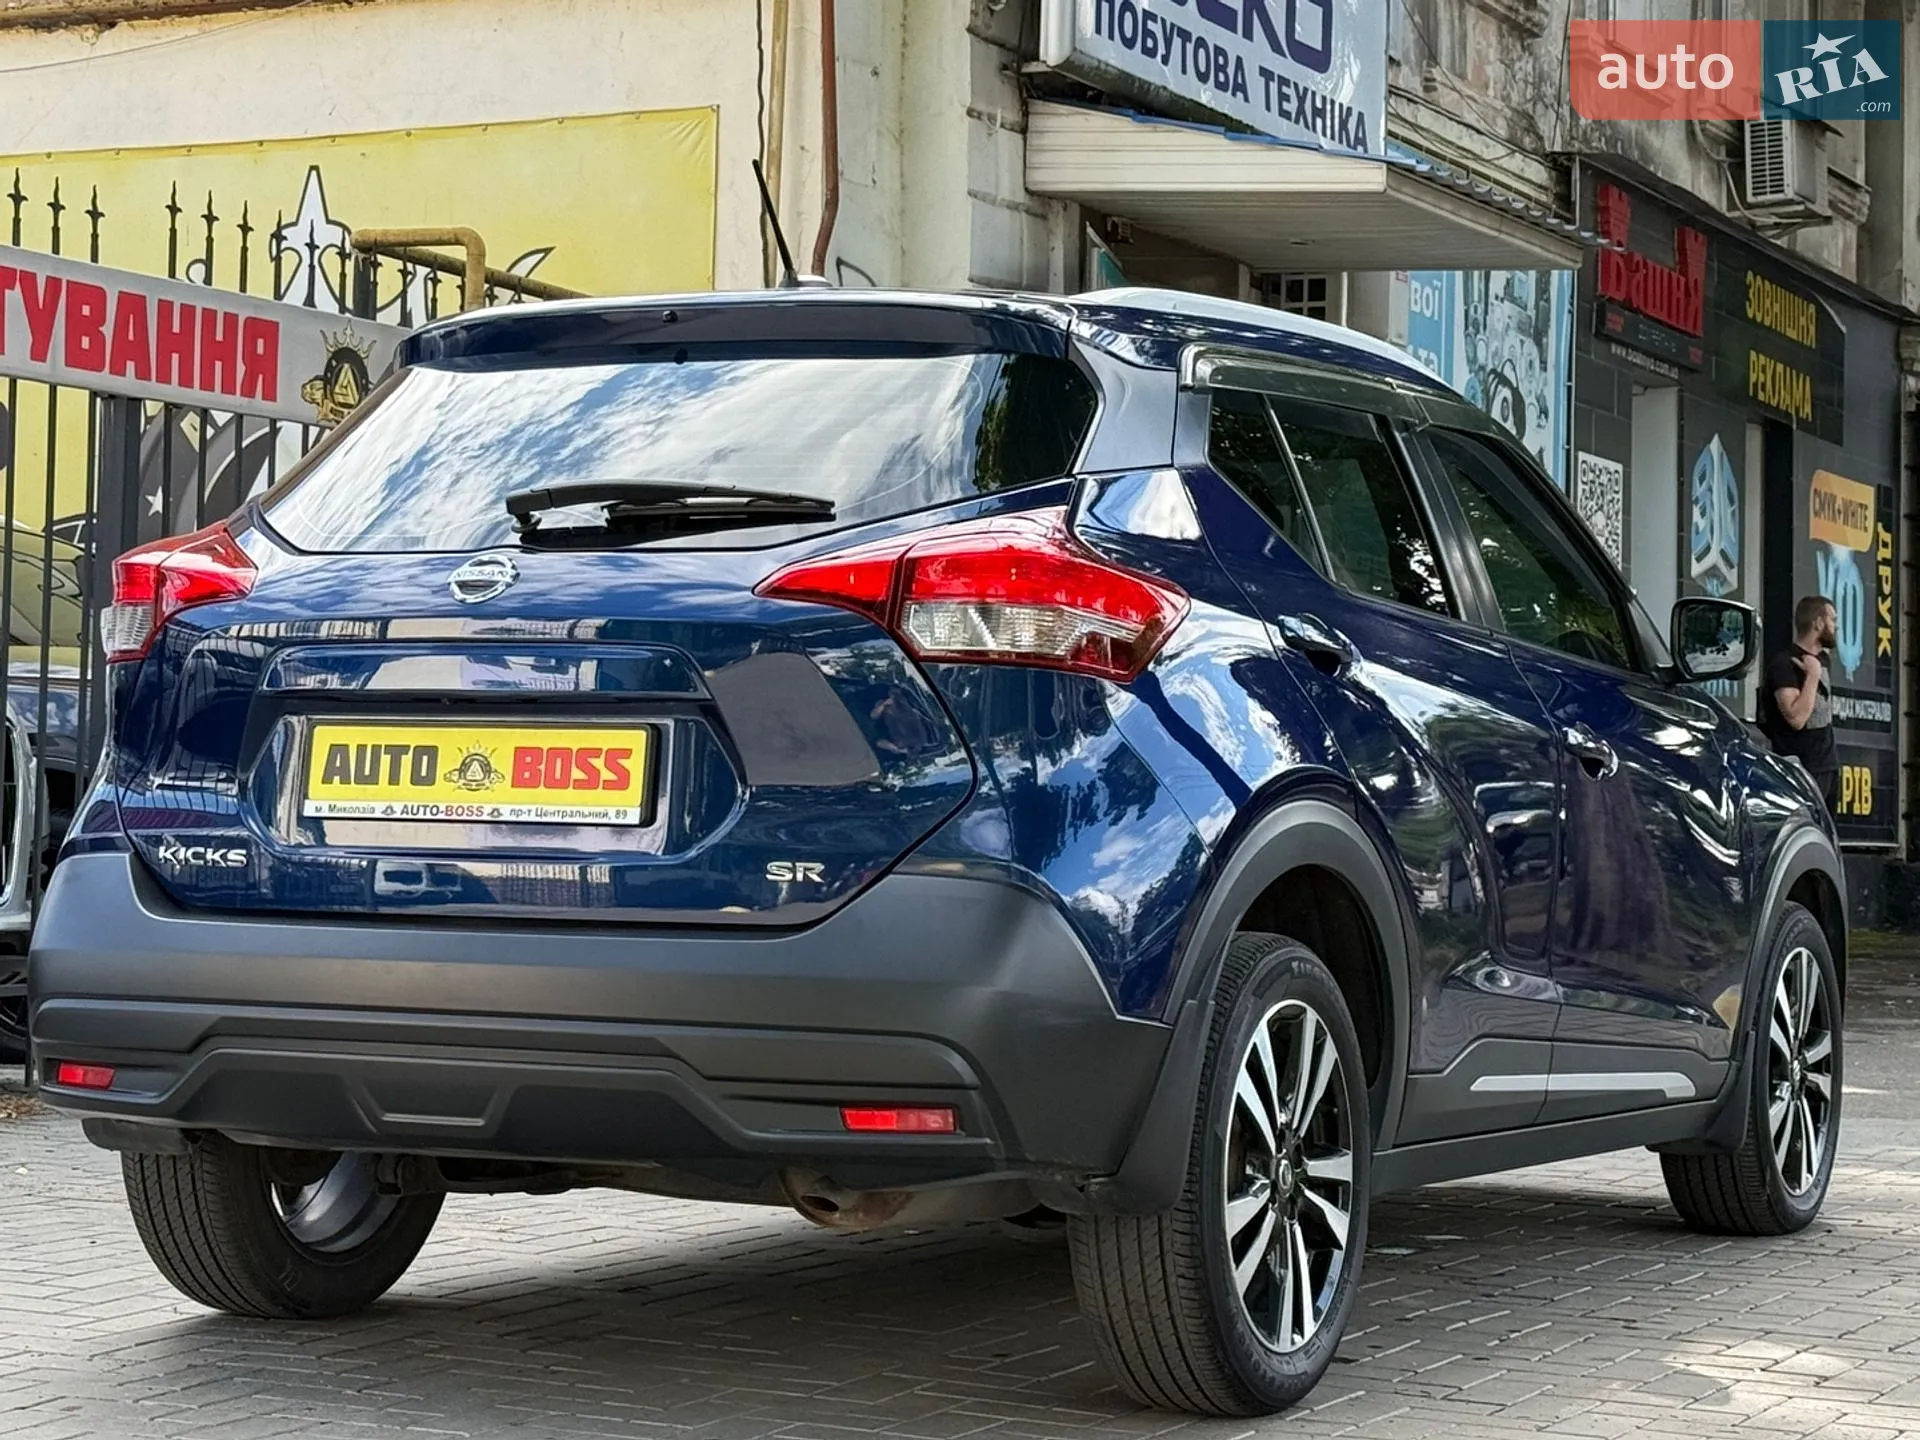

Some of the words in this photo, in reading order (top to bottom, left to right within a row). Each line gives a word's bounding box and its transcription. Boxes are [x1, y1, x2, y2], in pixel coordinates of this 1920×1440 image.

[1095, 0, 1249, 103] ПОБУТОВА
[1259, 65, 1368, 154] ТЕХНІКА
[1745, 270, 1816, 349] ЗОВНІШНЯ
[1749, 349, 1812, 422] РЕКЛАМА
[1877, 521, 1893, 658] ДРУК
[321, 743, 440, 786] AUTO
[511, 746, 633, 790] BOSS
[1838, 765, 1873, 816] РІВ
[400, 804, 484, 817] AUTO-BOSS
[614, 809, 628, 819] 89
[158, 845, 247, 868] KICKS
[765, 861, 825, 882] SR
